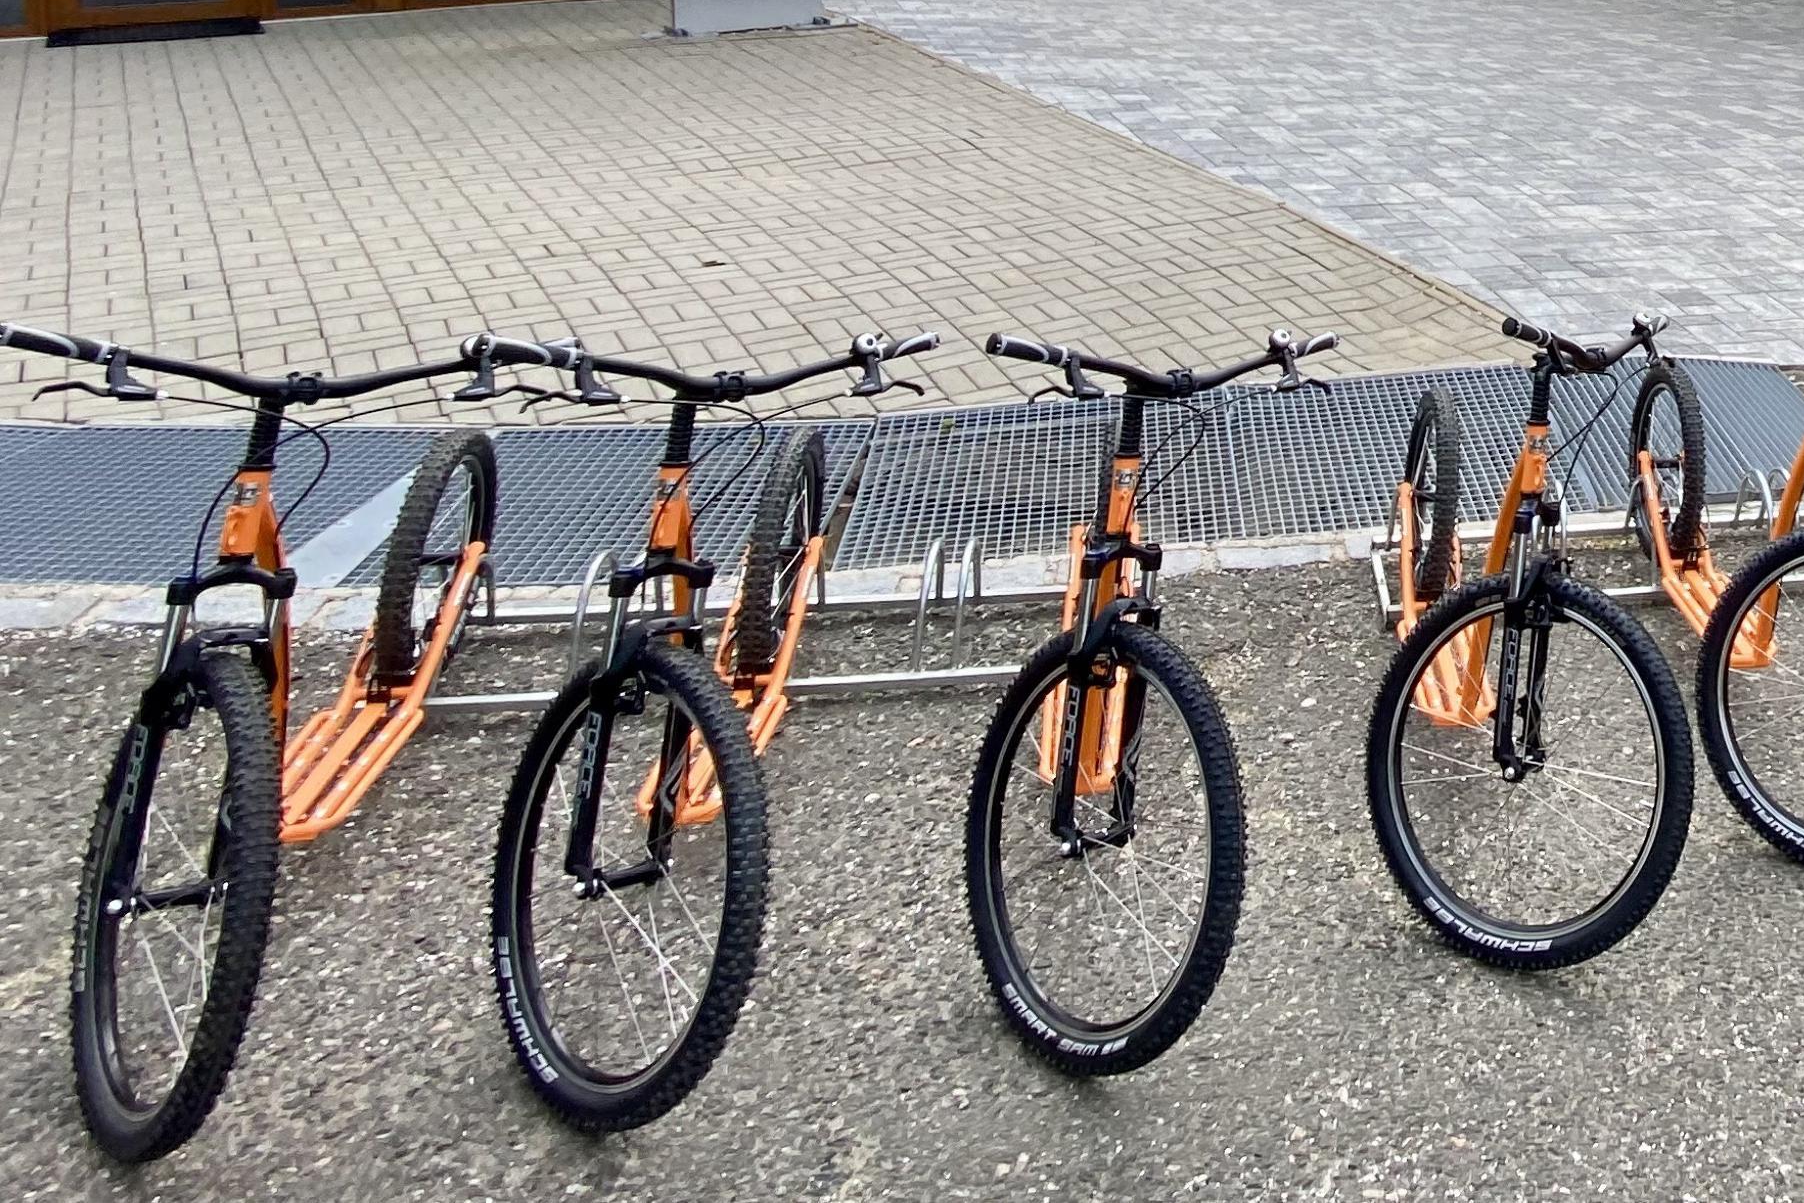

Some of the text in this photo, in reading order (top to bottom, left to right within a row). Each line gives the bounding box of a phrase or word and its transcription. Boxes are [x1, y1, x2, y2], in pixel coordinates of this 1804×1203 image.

[1504, 628, 1519, 700] FORCE
[577, 711, 602, 800] FORCE
[1061, 684, 1080, 767] FORCE
[1423, 896, 1553, 952] SCHWALBE
[498, 936, 558, 1084] SCHWALBE
[1002, 982, 1058, 1040] SMART
[1057, 1038, 1099, 1056] SAM
